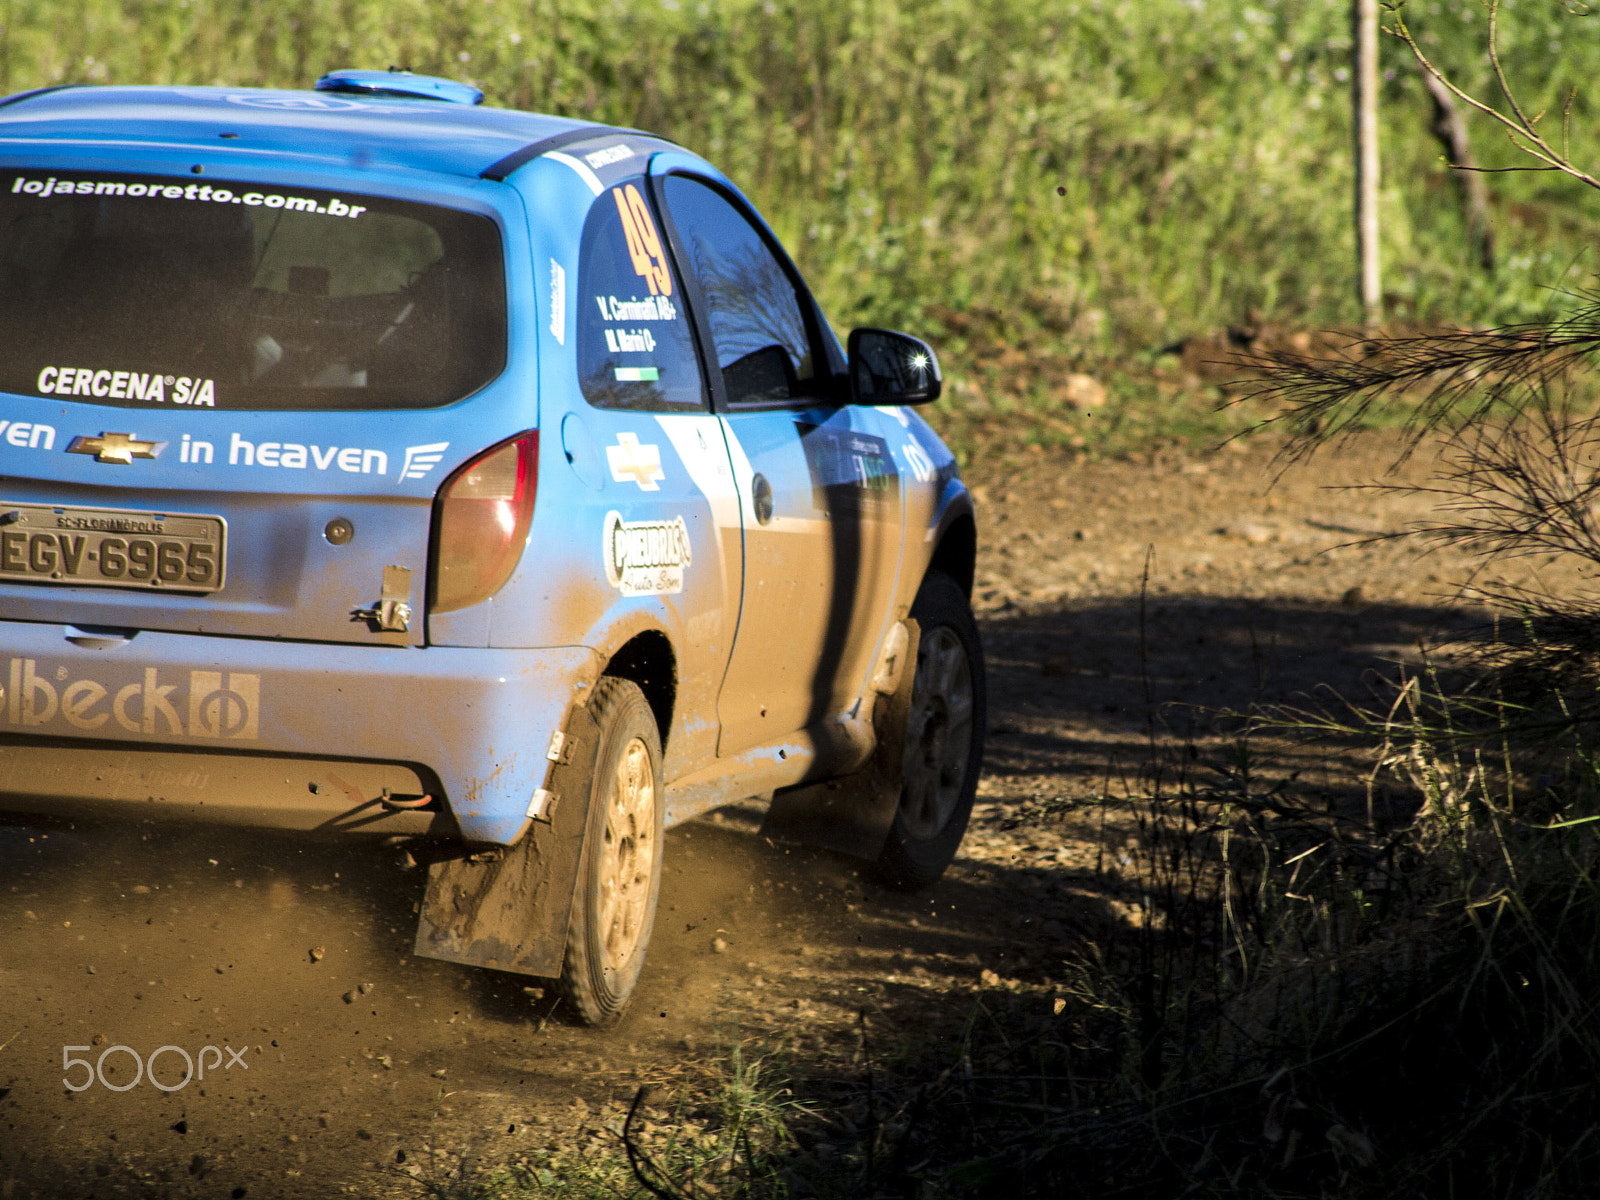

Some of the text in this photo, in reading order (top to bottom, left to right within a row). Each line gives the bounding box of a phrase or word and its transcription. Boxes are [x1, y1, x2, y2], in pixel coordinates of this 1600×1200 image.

[11, 177, 366, 219] lojasmoretto.com.br
[613, 184, 672, 297] 49
[179, 434, 214, 464] in
[228, 432, 388, 475] heaven
[0, 657, 184, 736] lbeck
